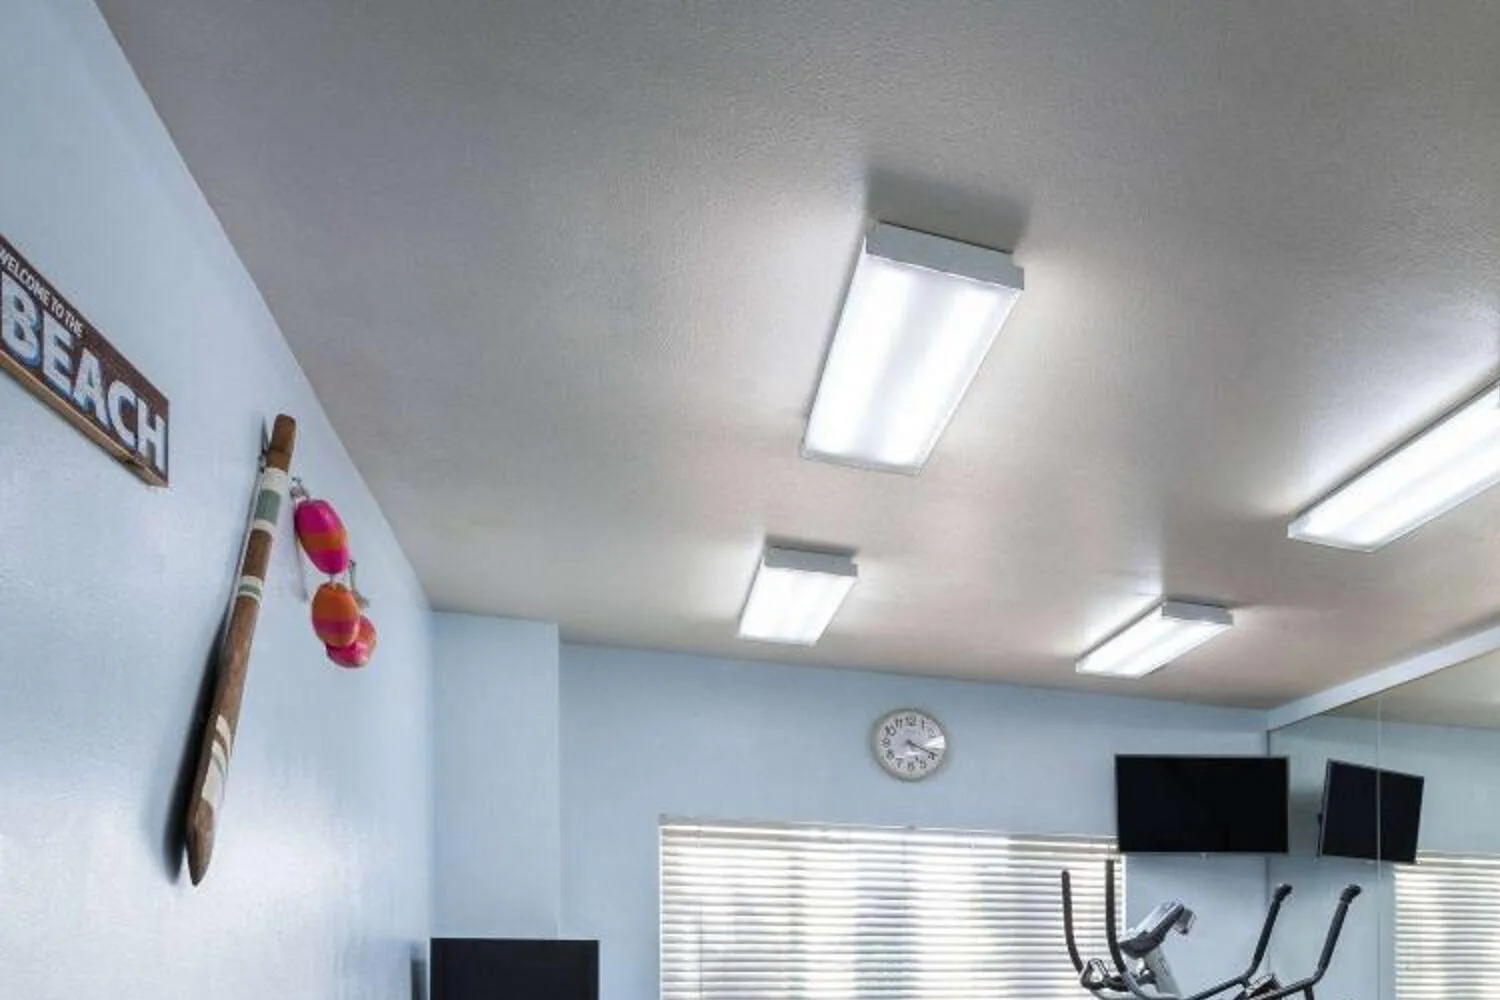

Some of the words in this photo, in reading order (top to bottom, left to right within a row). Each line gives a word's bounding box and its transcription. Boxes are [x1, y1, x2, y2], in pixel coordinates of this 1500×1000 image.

[1, 271, 165, 477] BEACH
[51, 296, 65, 318] TO
[65, 310, 84, 338] THE
